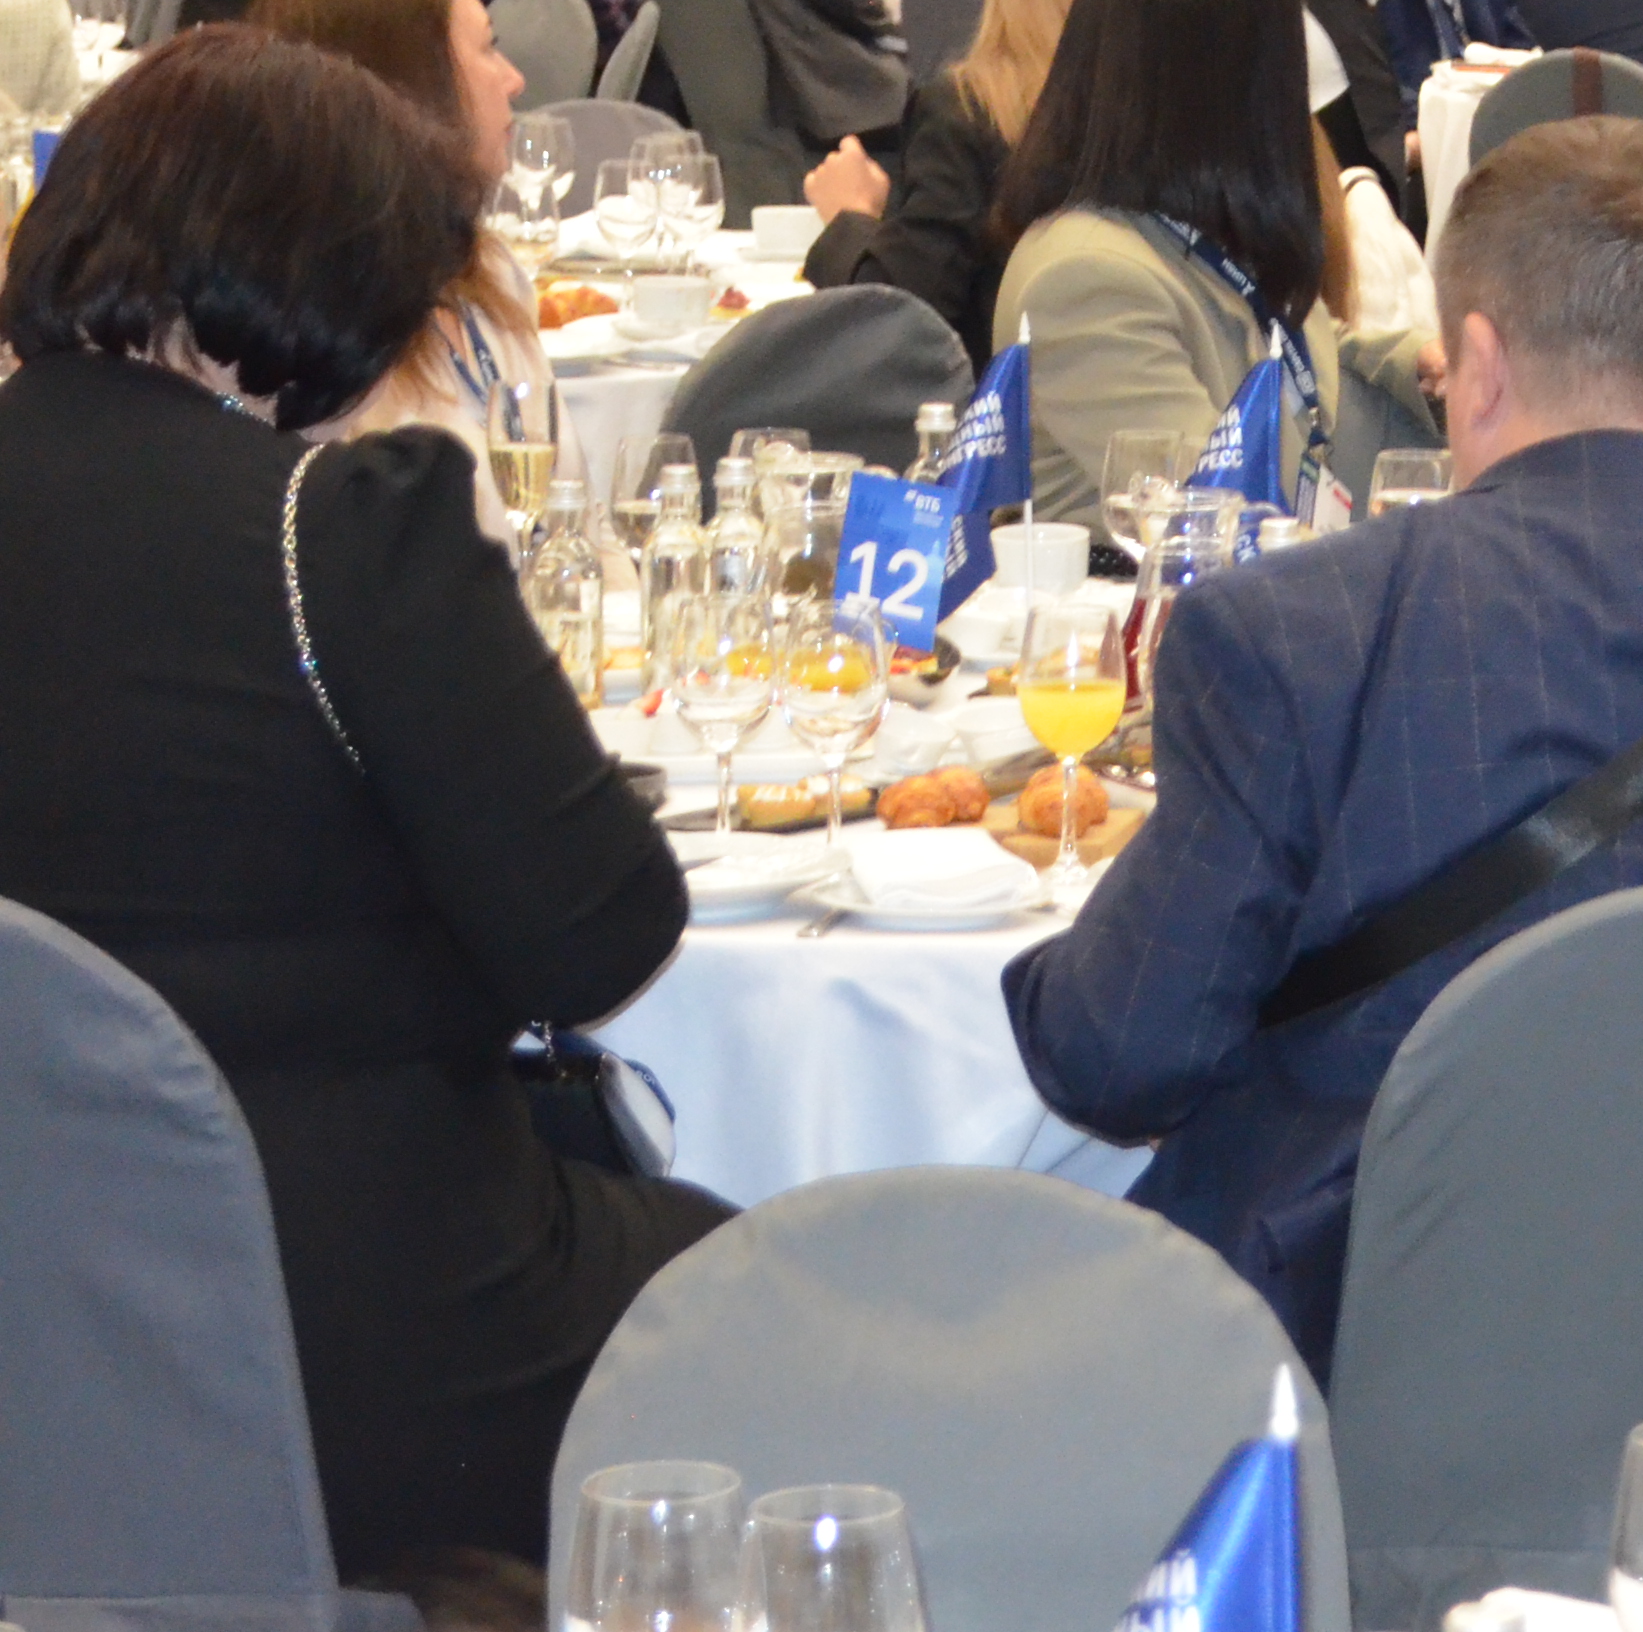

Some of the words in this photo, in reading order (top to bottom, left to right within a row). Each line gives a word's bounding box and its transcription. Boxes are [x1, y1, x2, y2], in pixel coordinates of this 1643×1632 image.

[1198, 448, 1243, 473] РЕСС
[915, 494, 941, 512] ВТБ
[842, 540, 929, 621] 12
